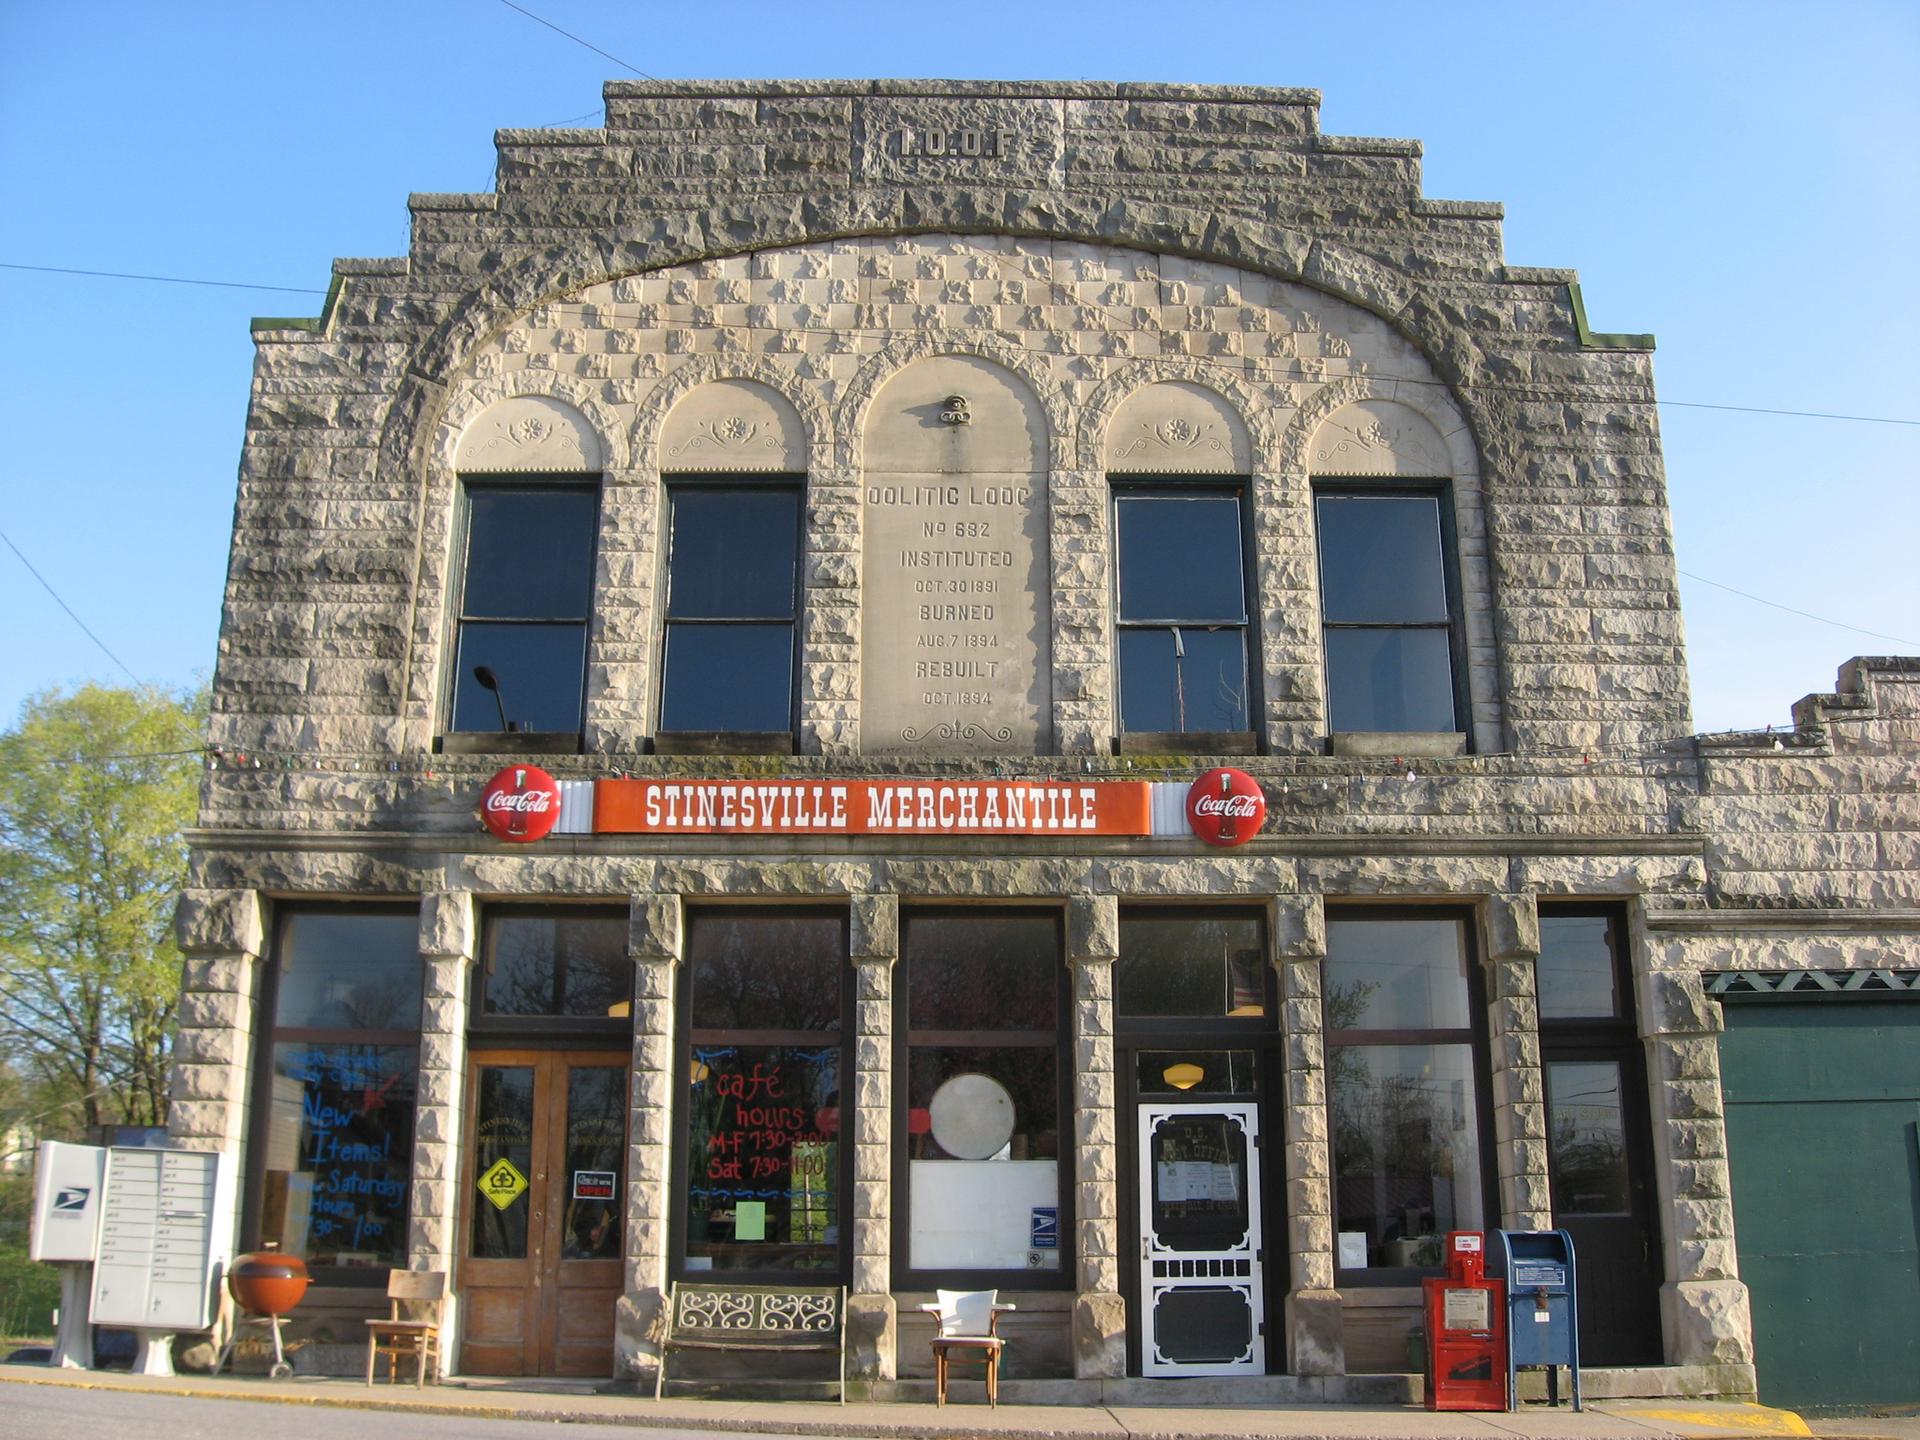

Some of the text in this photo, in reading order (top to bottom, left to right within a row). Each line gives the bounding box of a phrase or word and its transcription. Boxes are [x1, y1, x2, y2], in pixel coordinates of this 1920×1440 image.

[867, 487, 1034, 506] OOLITIC LODG
[954, 522, 990, 538] 682
[900, 551, 1013, 568] INSTITUTED
[919, 605, 995, 622] BURNED
[964, 634, 999, 648] 1894
[916, 661, 999, 678] REBUILT
[487, 790, 553, 813] Coca-Cola
[646, 785, 1097, 829] STINESVILLE MERCHANTILE
[1195, 794, 1257, 818] Coca-Cola
[717, 1062, 784, 1101] café
[303, 1091, 353, 1128] New
[737, 1104, 805, 1129] hours
[307, 1131, 390, 1163] Items!
[708, 1131, 743, 1153] M-F
[707, 1156, 743, 1180] Sat
